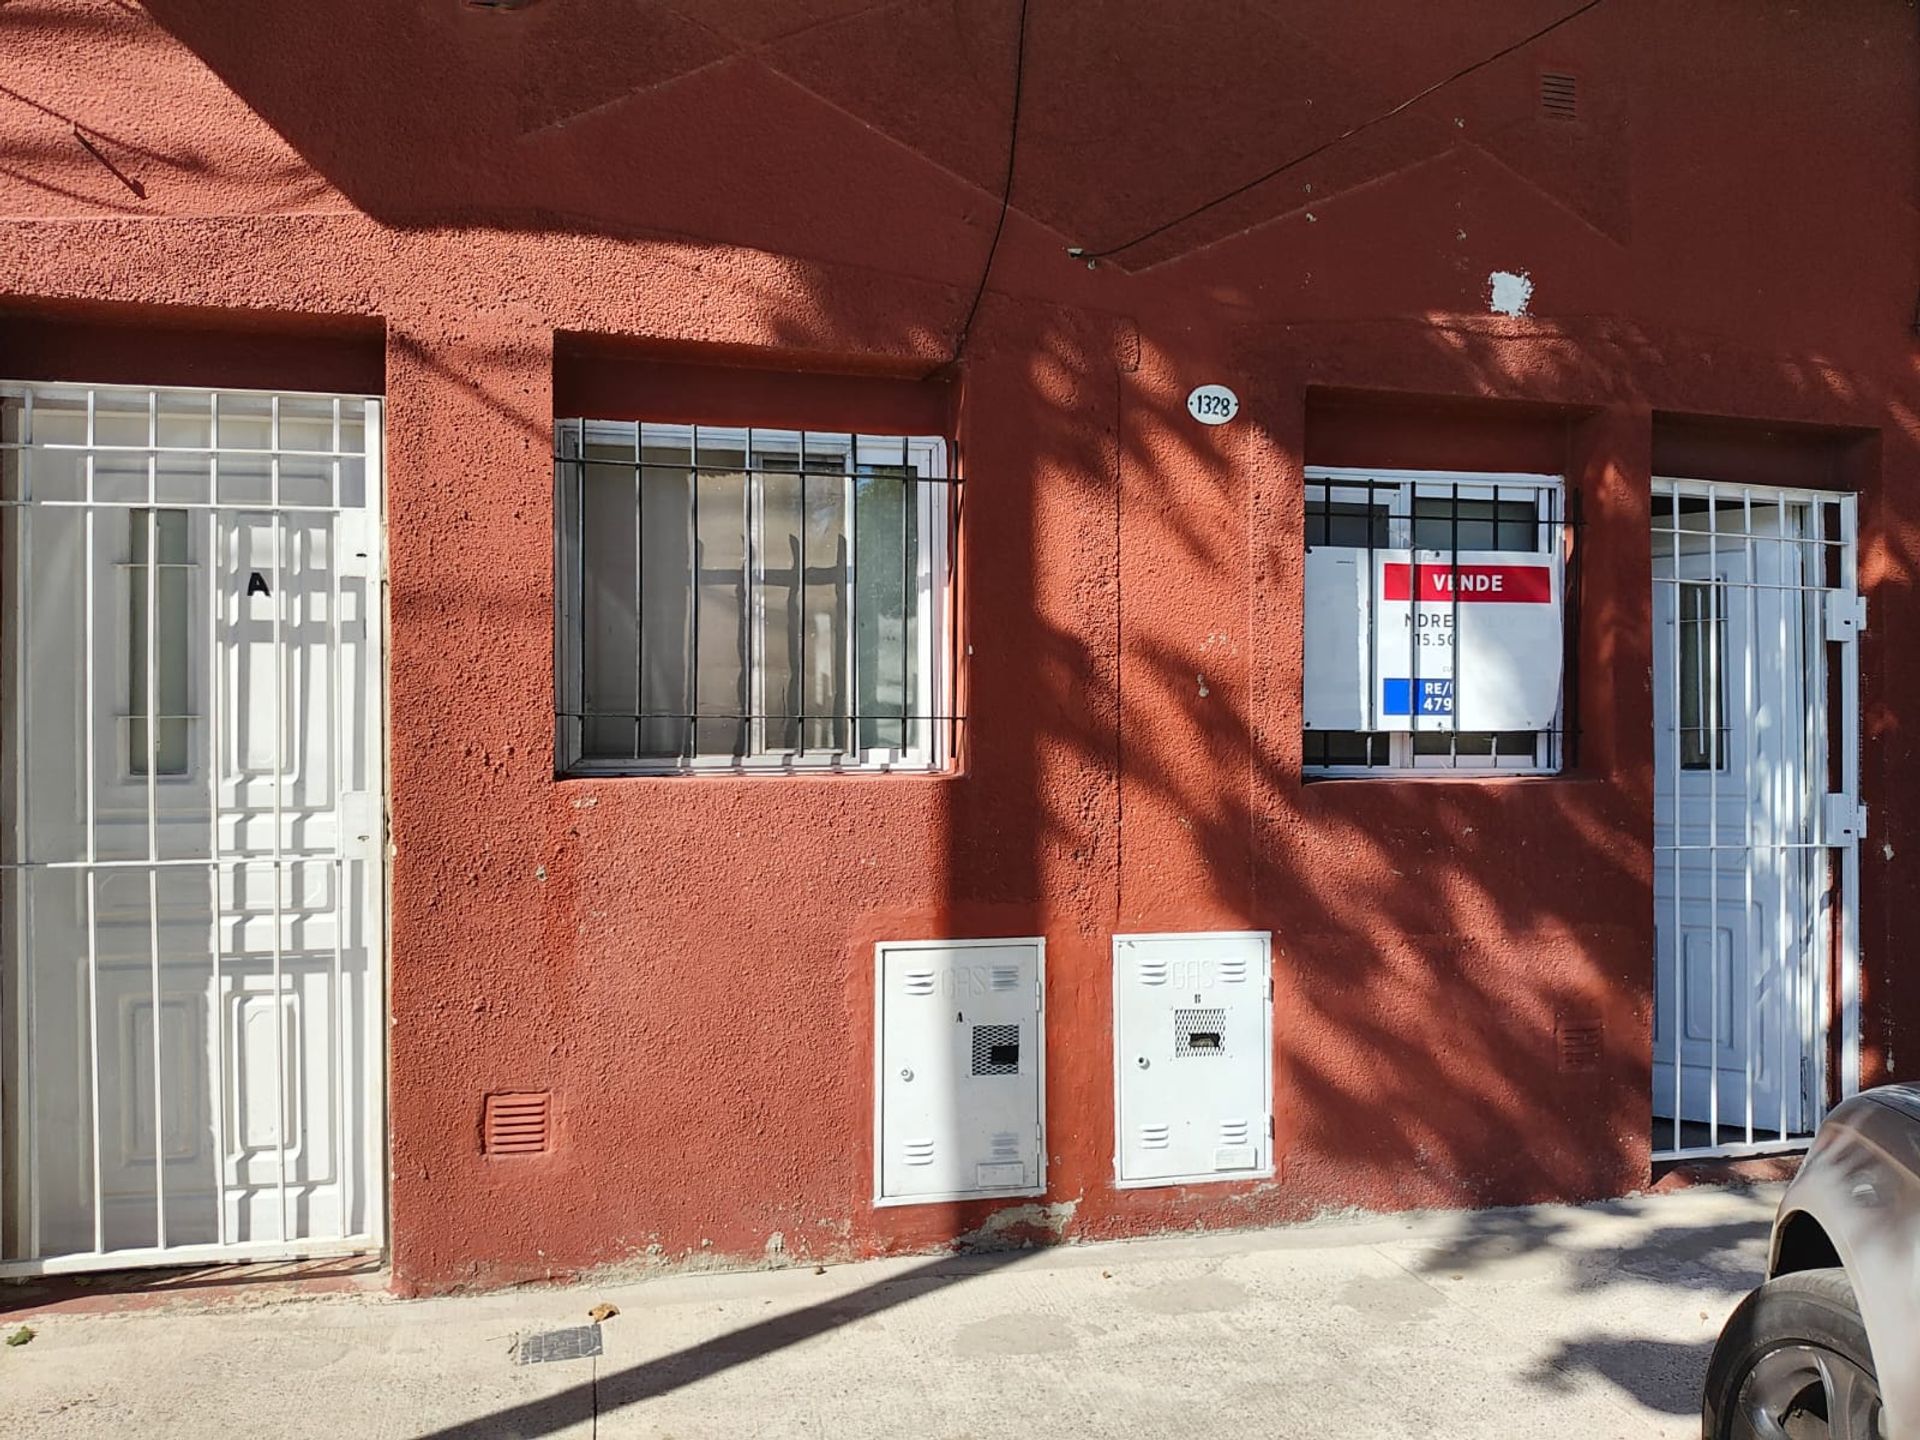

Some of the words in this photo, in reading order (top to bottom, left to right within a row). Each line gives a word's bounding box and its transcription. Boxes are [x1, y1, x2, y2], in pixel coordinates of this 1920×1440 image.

[1197, 394, 1231, 418] 1328
[247, 571, 271, 597] A
[1432, 573, 1503, 592] VENDE
[1425, 681, 1453, 696] RE/
[1423, 697, 1452, 711] 479
[940, 965, 988, 999] GAS
[1172, 960, 1215, 990] GAS
[956, 1010, 964, 1023] A
